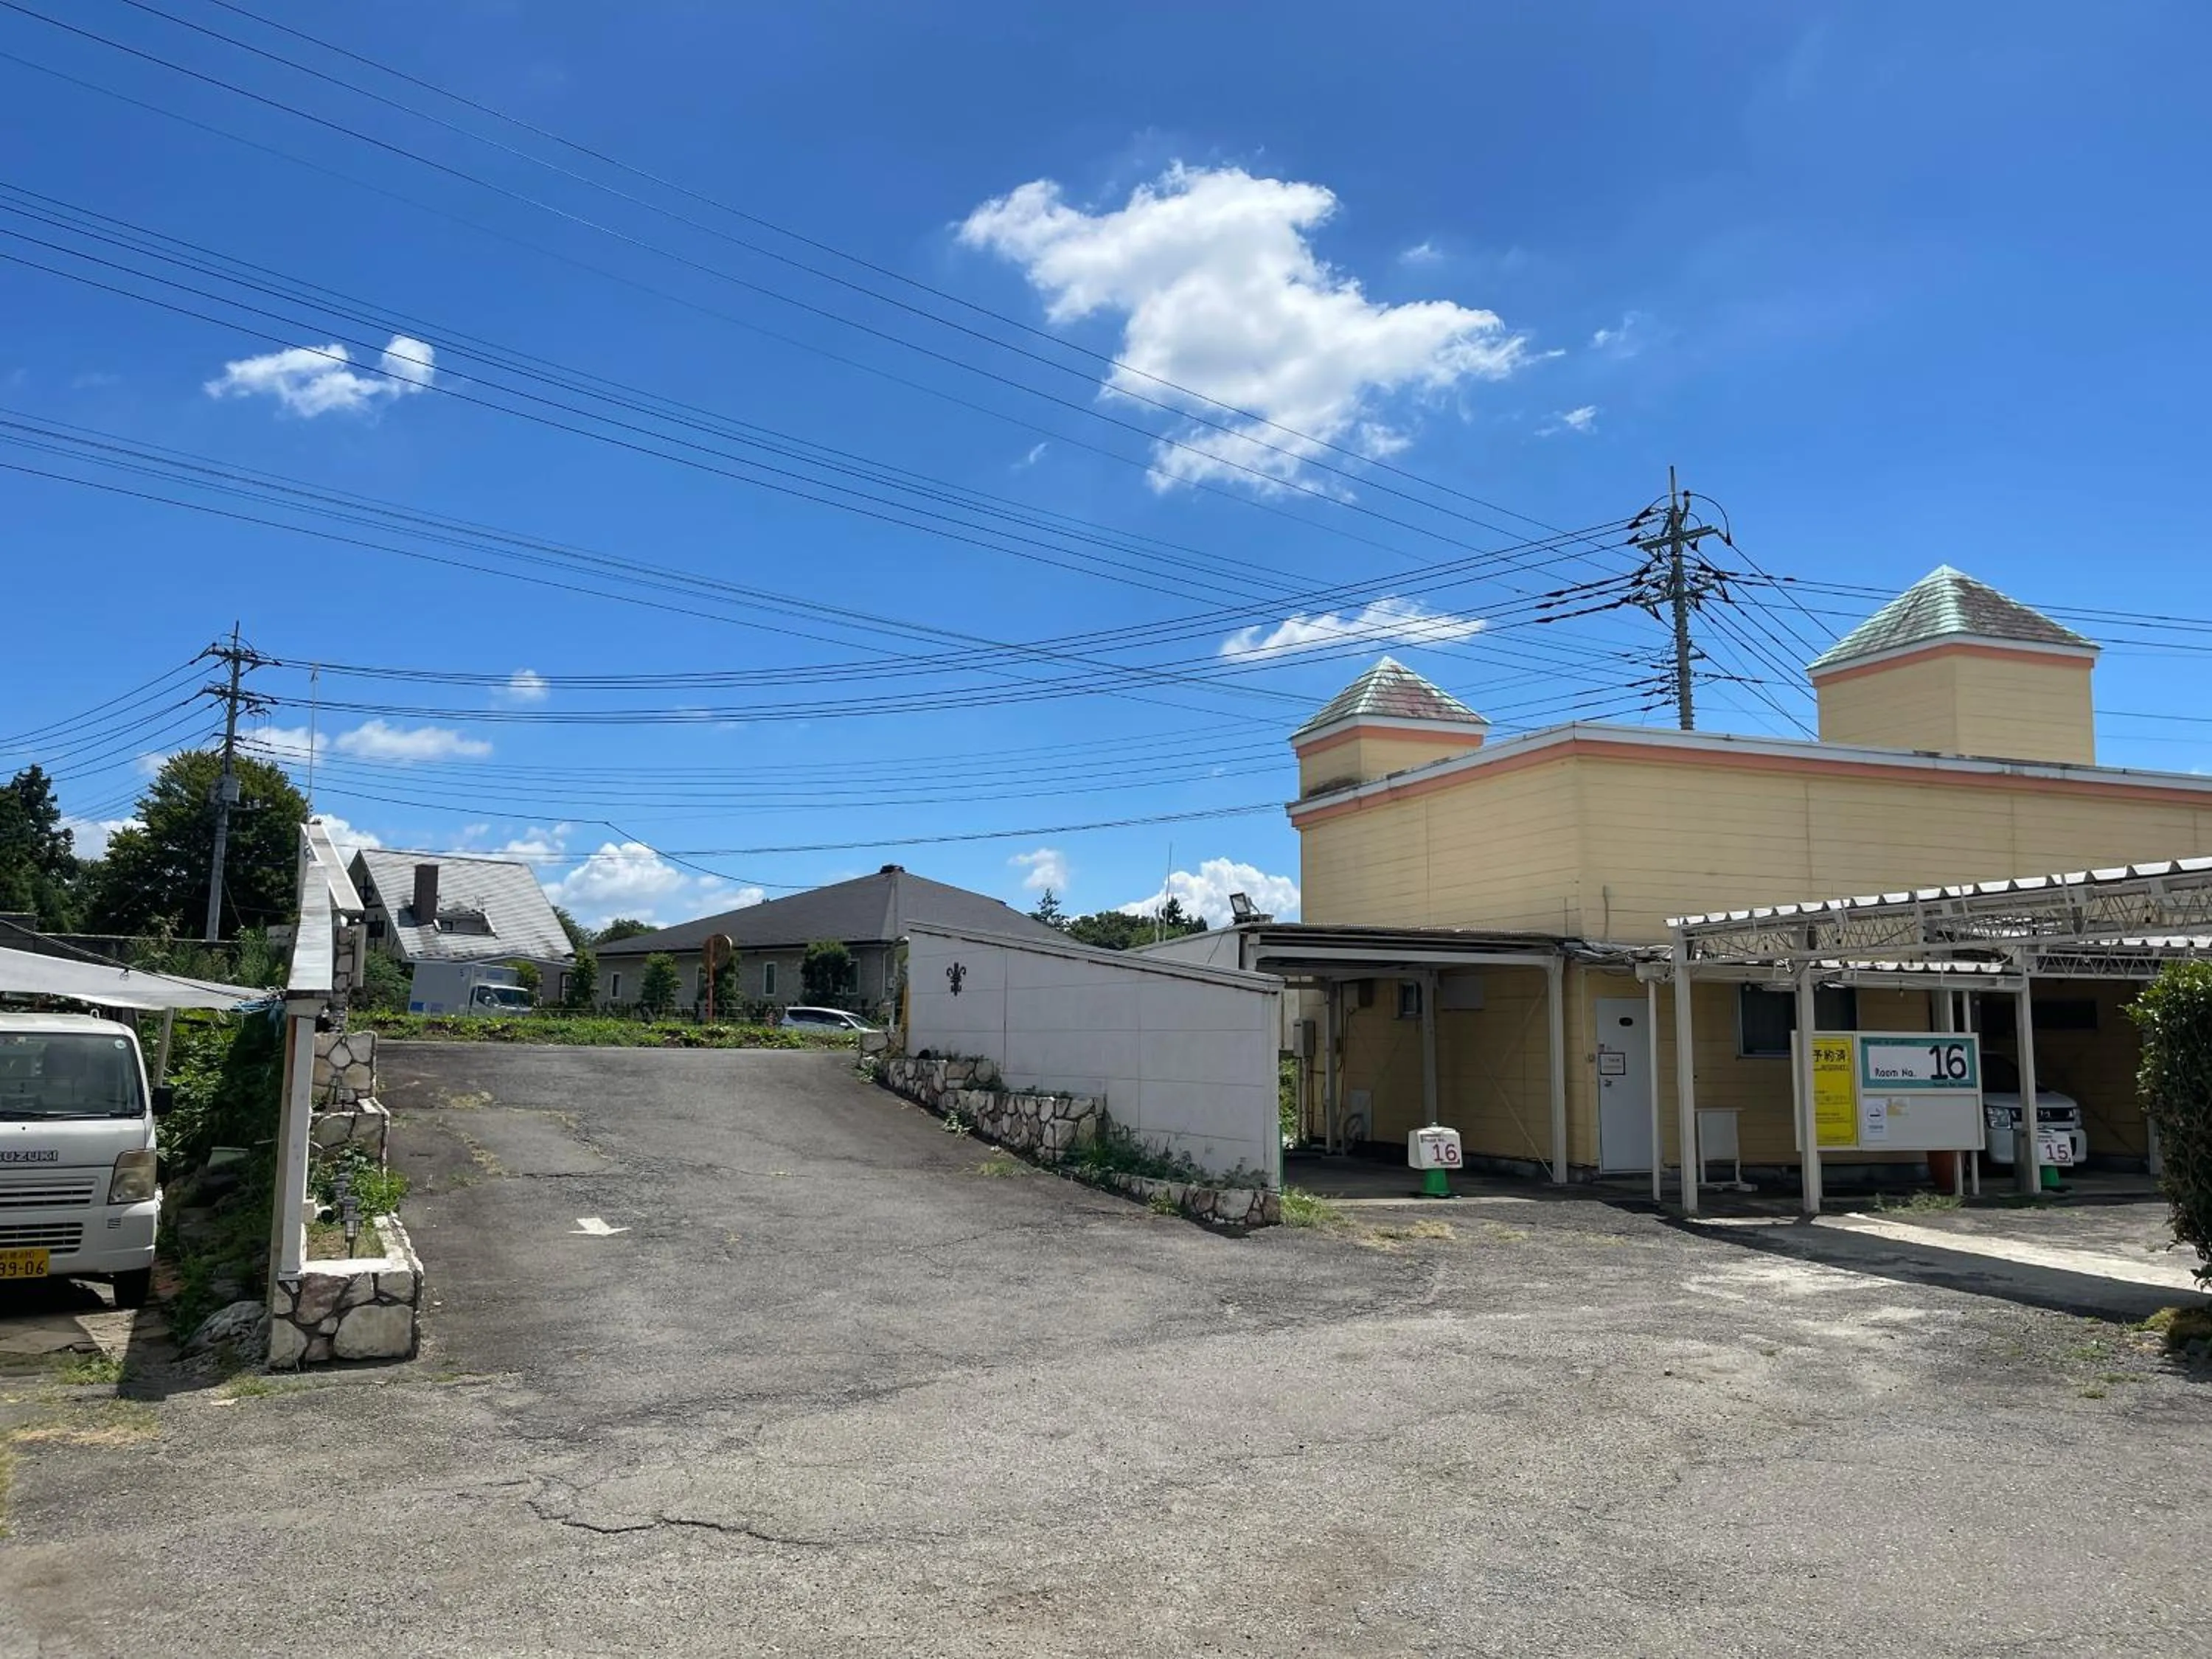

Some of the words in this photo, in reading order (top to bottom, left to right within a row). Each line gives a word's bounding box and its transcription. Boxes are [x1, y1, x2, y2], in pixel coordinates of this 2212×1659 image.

[1875, 1068, 1899, 1077] Room
[1902, 1068, 1917, 1077] No.
[1929, 1044, 1966, 1079] 16
[1433, 1144, 1457, 1161] 16
[2045, 1144, 2068, 1160] 15
